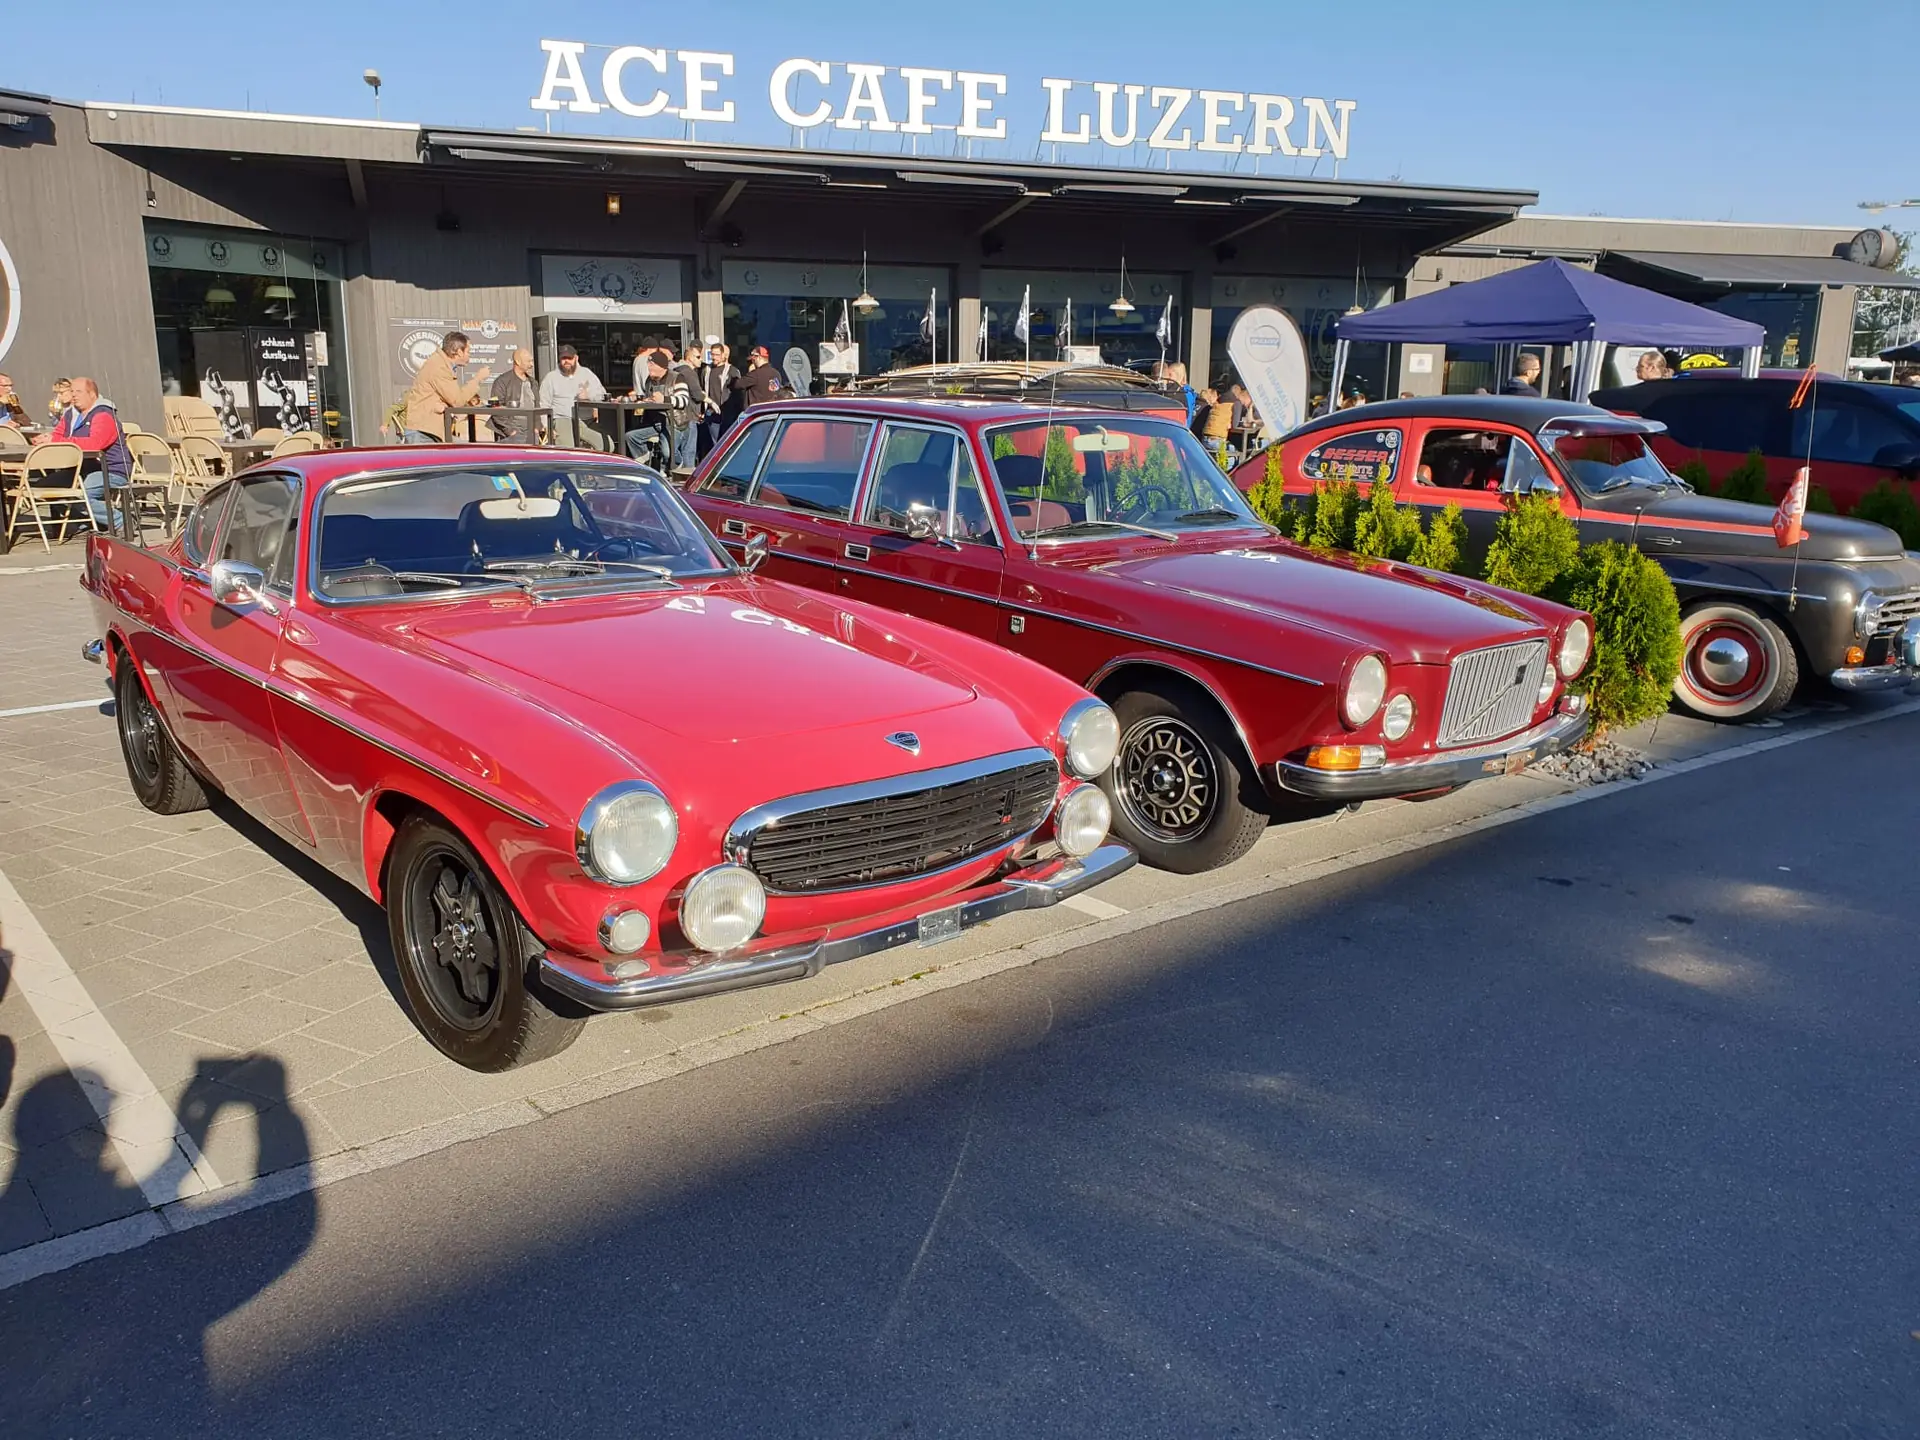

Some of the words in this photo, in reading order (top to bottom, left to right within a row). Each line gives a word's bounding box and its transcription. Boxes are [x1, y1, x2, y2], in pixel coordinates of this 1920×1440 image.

[530, 39, 735, 123] ACE
[769, 58, 1007, 139] CAFE
[1041, 77, 1358, 159] LUZERN
[402, 331, 443, 350] FEUERRIN
[1322, 447, 1388, 463] BESSER
